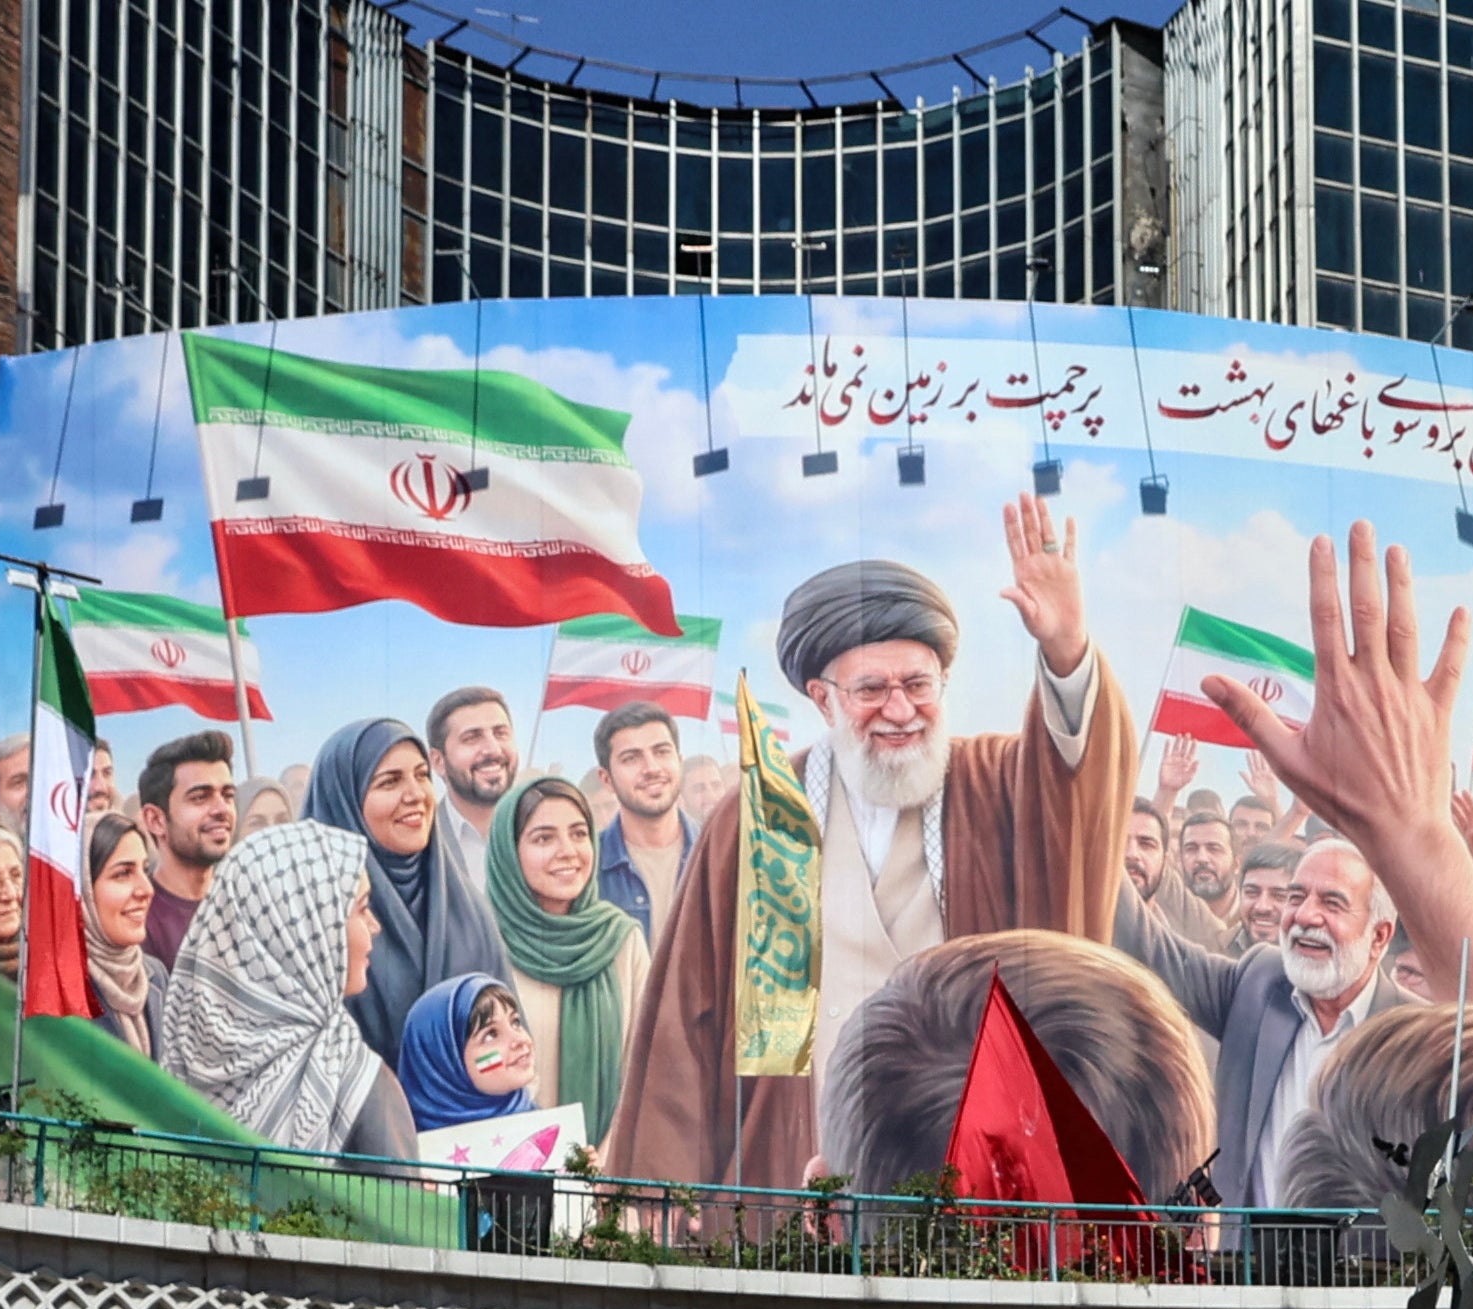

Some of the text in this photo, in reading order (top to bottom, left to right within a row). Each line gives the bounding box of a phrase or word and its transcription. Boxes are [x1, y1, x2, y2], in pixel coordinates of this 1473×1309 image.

[868, 361, 948, 426] زمین
[949, 378, 980, 423] بر
[986, 364, 1104, 437] پرچمت
[1158, 359, 1275, 425] بهشت
